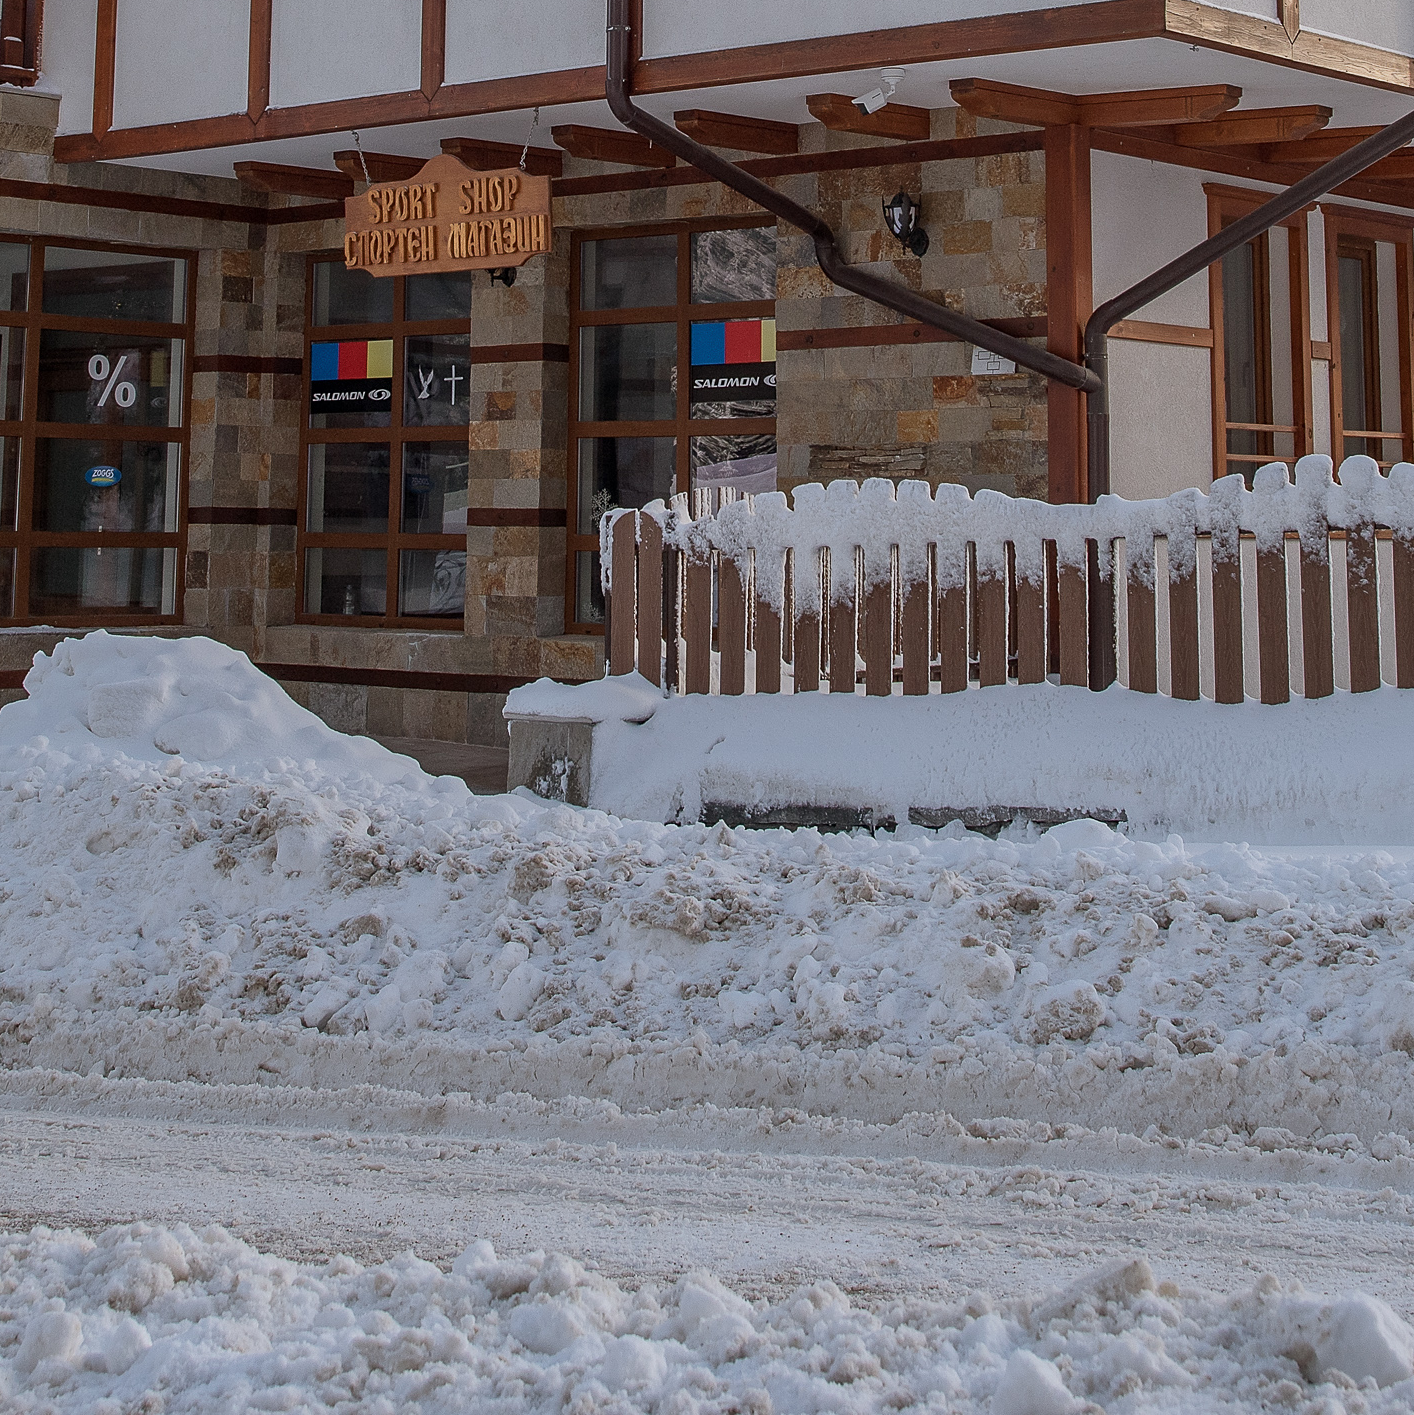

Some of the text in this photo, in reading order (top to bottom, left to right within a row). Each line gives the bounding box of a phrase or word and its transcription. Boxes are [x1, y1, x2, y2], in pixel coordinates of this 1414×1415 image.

[366, 174, 520, 224] SPORT SHOP
[344, 225, 437, 267] СПОРТЕН
[693, 376, 760, 389] SALOMON
[312, 391, 366, 402] SALOMON
[91, 468, 115, 479] ZOGGS
